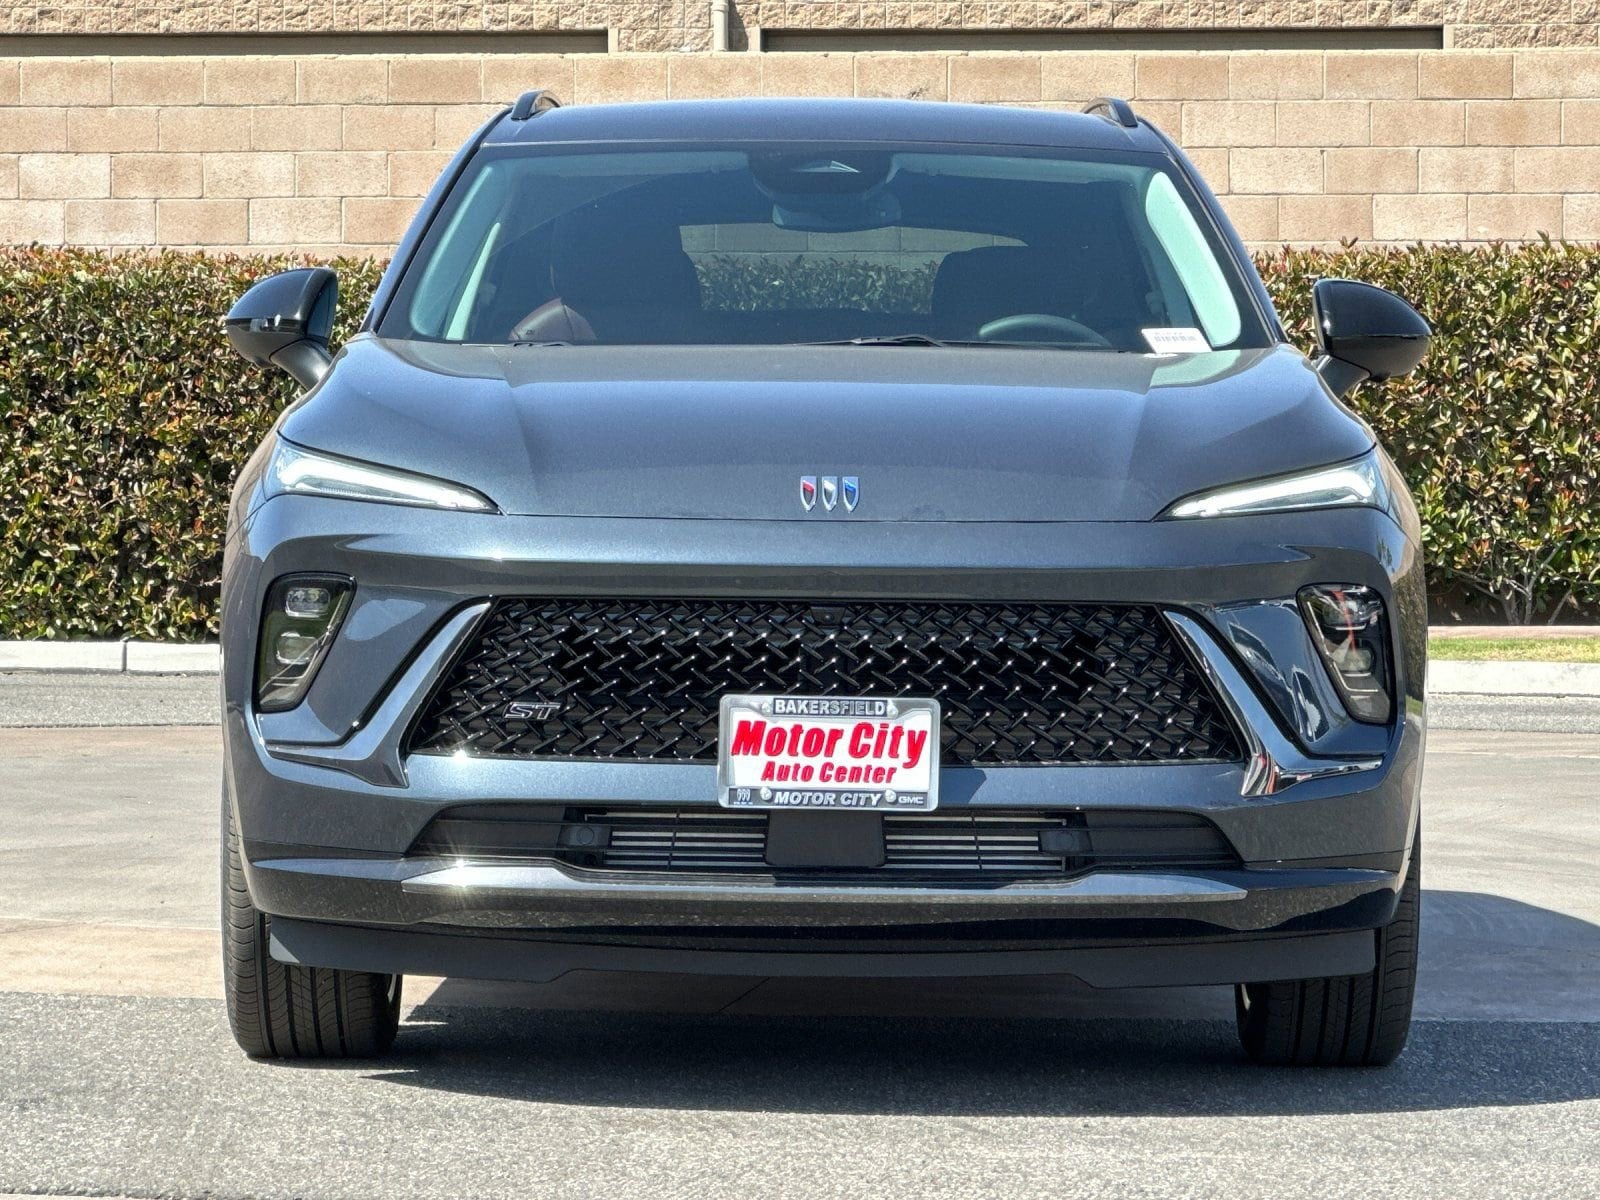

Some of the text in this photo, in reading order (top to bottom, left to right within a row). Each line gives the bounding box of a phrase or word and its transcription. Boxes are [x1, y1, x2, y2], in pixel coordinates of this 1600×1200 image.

[504, 702, 560, 720] ST
[775, 699, 886, 716] BAKERSFIELD
[731, 720, 928, 769] Motor City
[761, 761, 898, 784] Auto Center
[774, 791, 882, 807] MOTOR CITY
[898, 796, 924, 805] GMC
